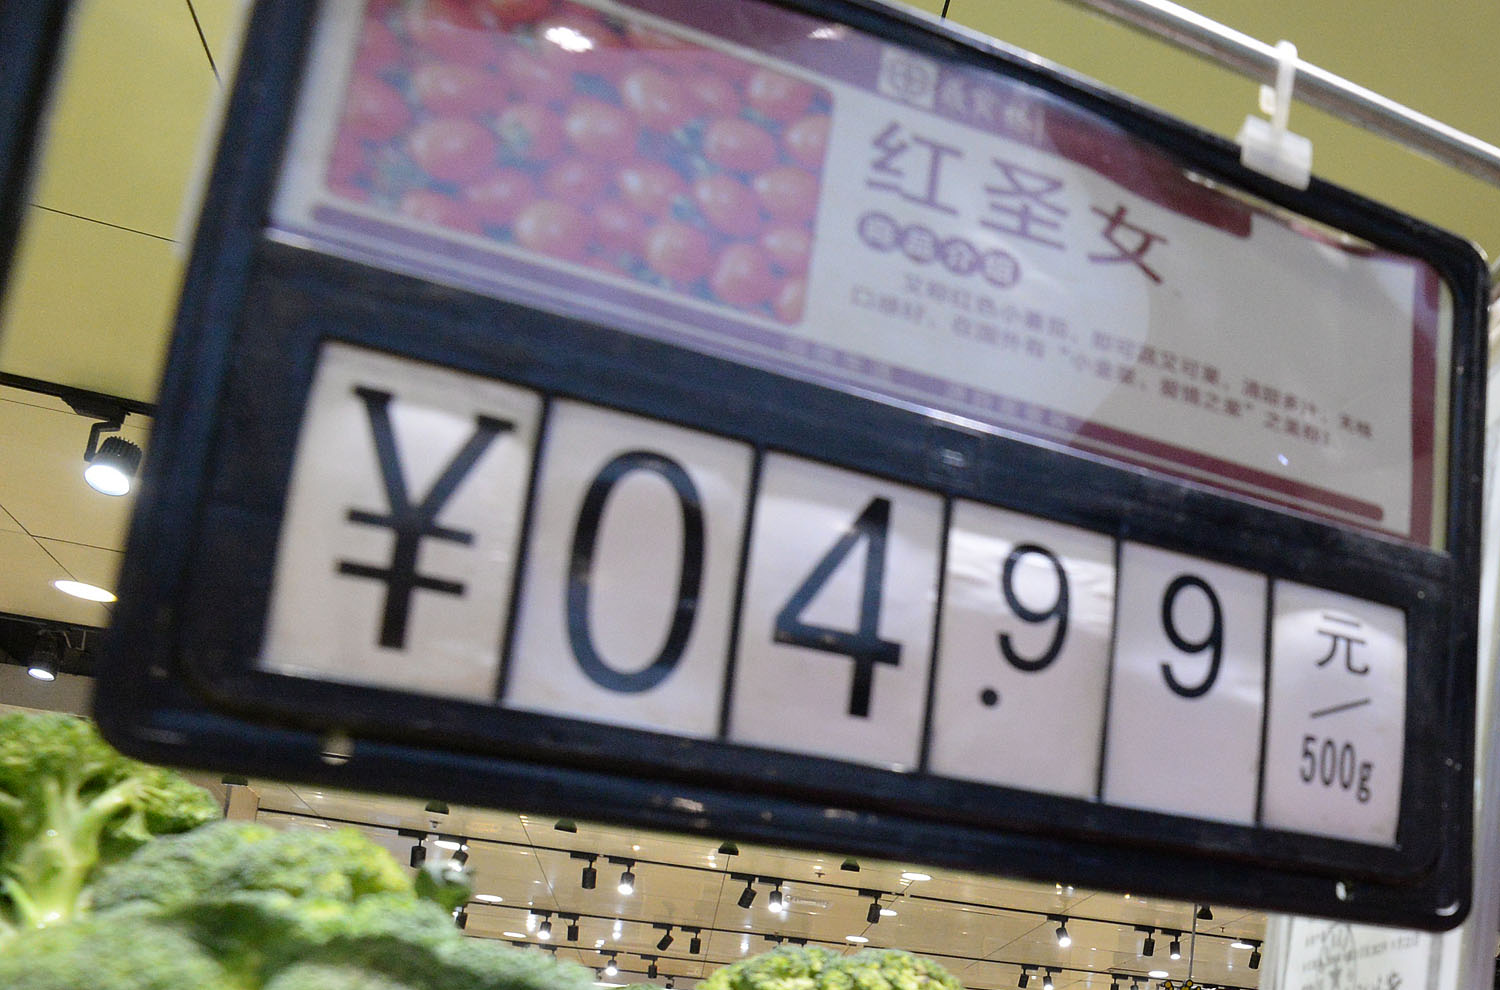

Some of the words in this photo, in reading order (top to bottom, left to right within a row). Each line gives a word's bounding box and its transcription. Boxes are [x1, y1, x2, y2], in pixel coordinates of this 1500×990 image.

[865, 121, 1171, 288] 红圣女
[1316, 613, 1371, 677] 元
[1299, 734, 1375, 804] 500g
